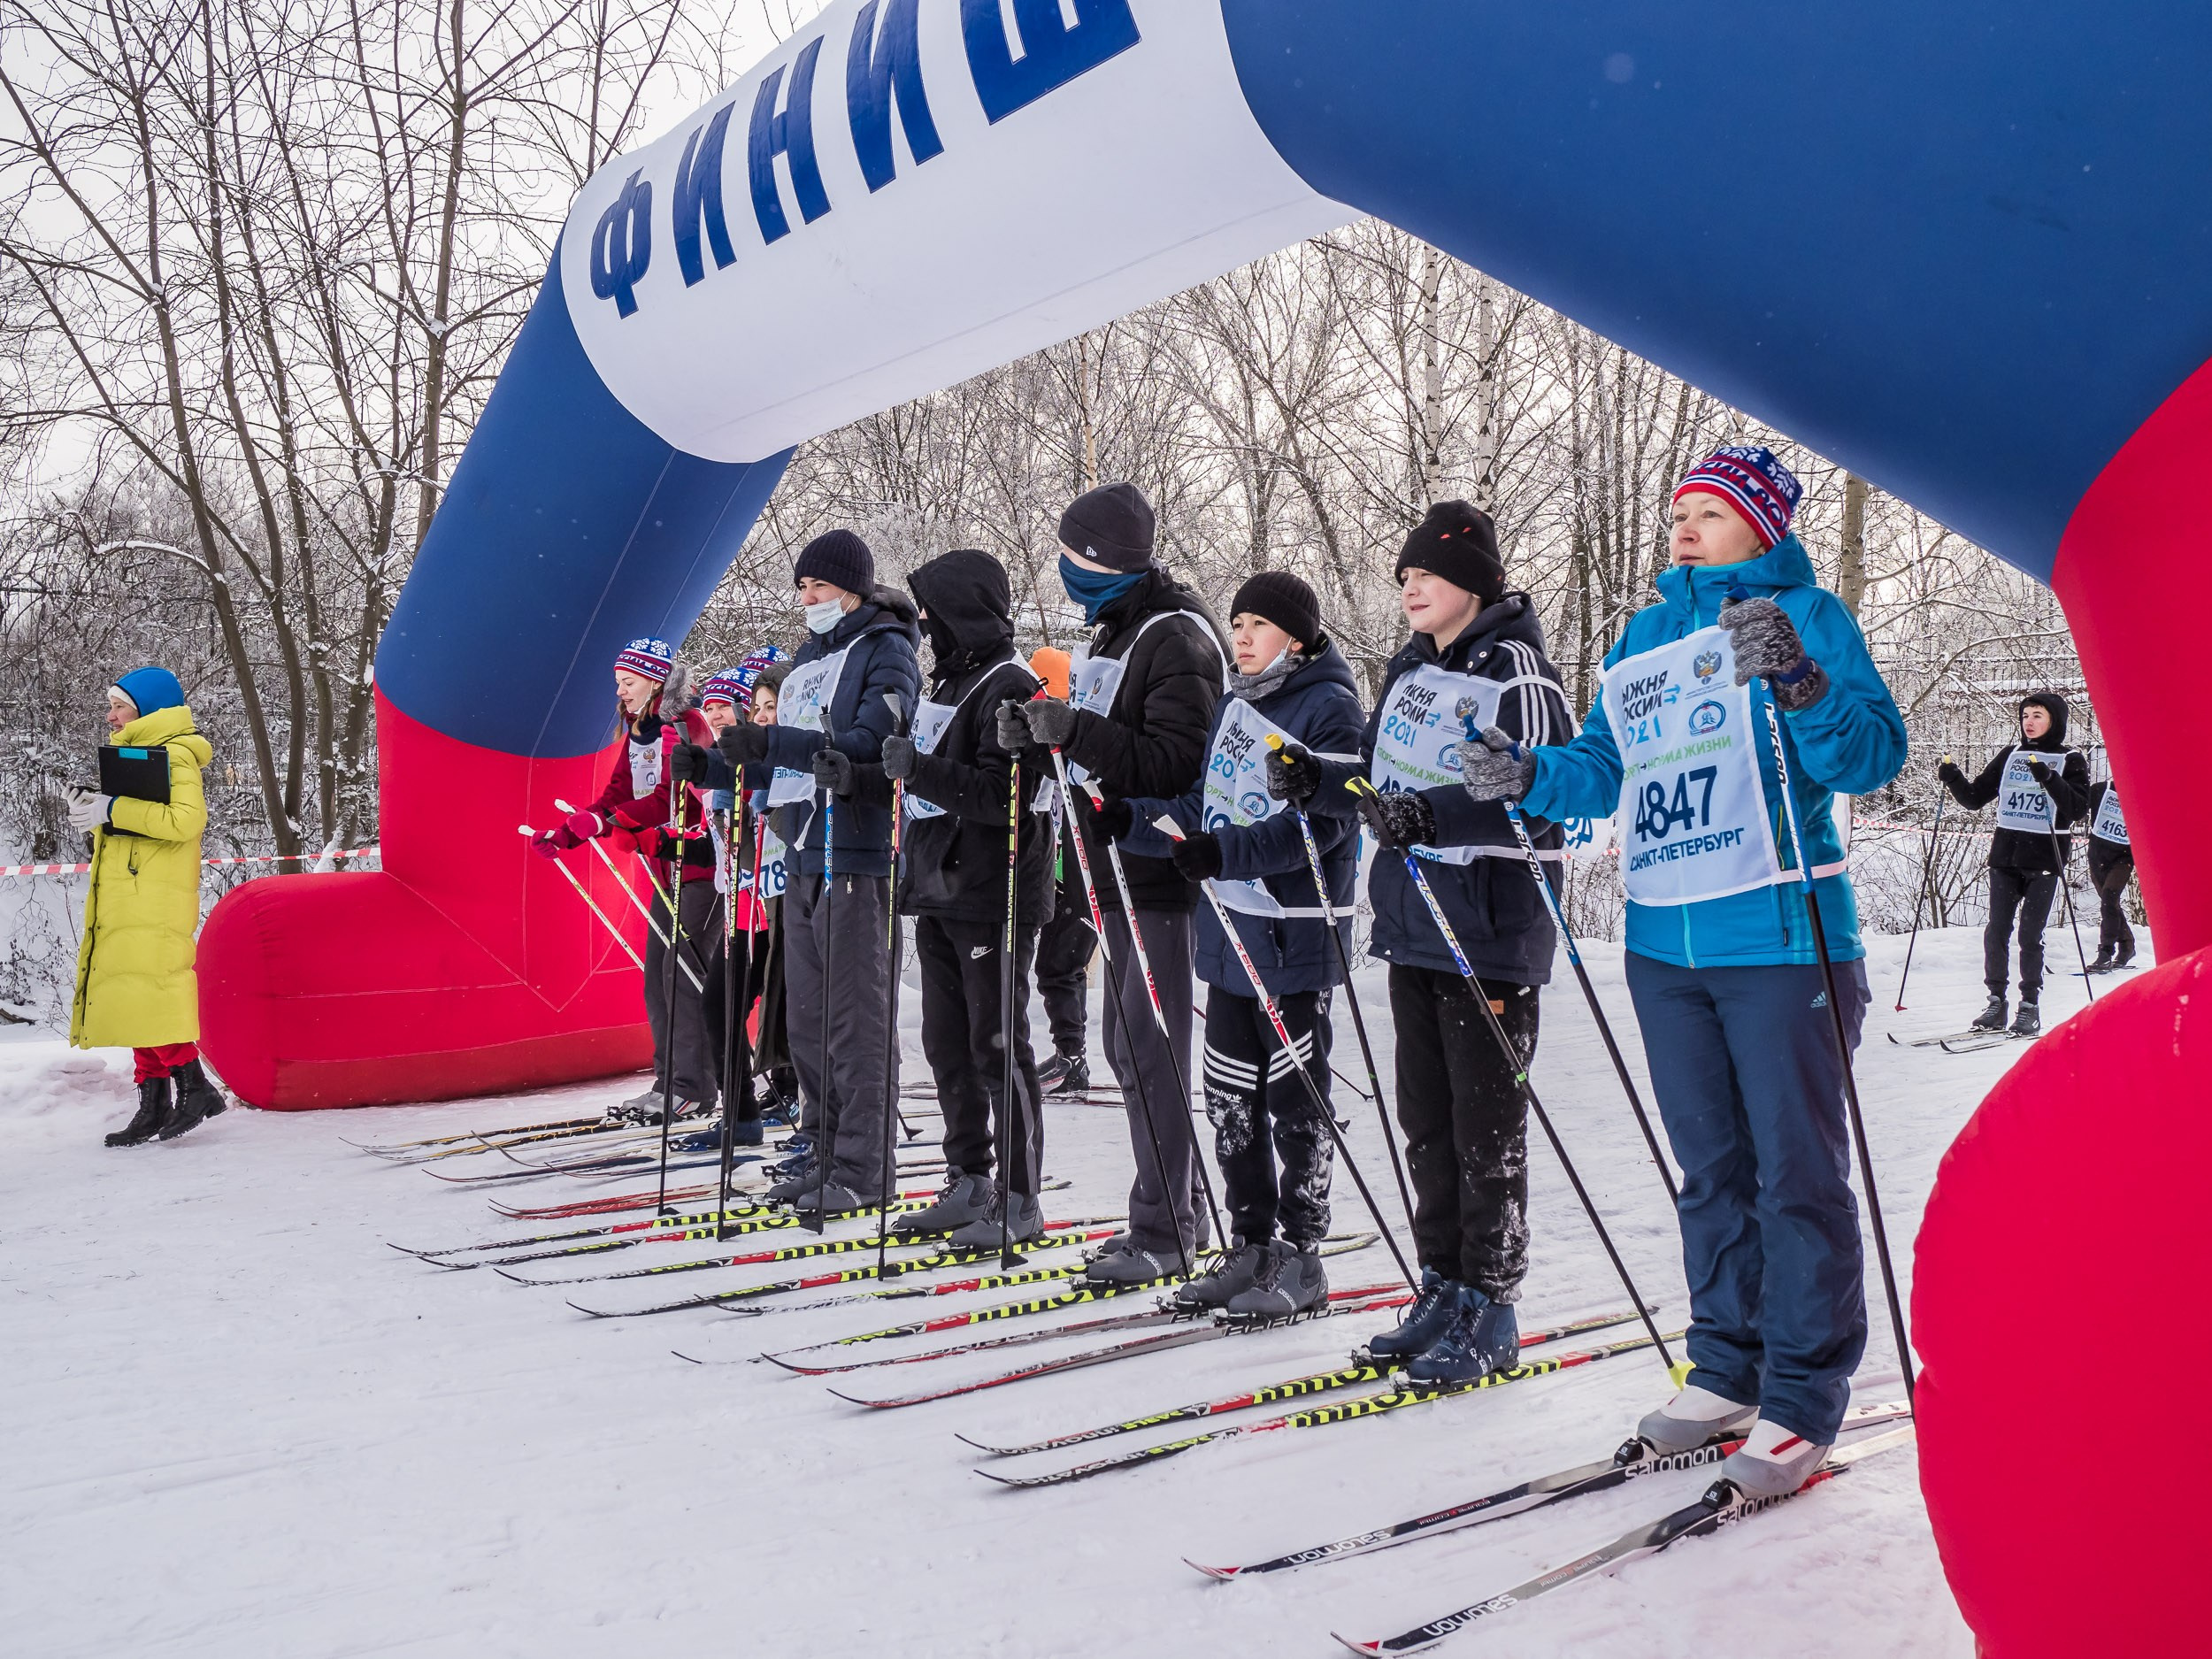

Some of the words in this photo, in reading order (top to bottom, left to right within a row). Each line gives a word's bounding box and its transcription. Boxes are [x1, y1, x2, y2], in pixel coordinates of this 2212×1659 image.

[1622, 670, 1668, 705] ЫЖНЯ
[1624, 690, 1663, 724] ОССИИ
[1626, 714, 1662, 749] 021
[1684, 735, 1732, 758] ЖИЗНИ
[1635, 765, 1717, 842] 4847
[2008, 792, 2045, 812] 4179
[2101, 820, 2127, 837] 4163
[1630, 827, 1745, 872] САНКТ-ПЕТЕРБУРГ
[760, 860, 787, 897] 78
[973, 946, 987, 955] NIKE
[1624, 1446, 1718, 1480] salomon
[1287, 1529, 1393, 1564] salomon
[1423, 1594, 1518, 1637] salomon
